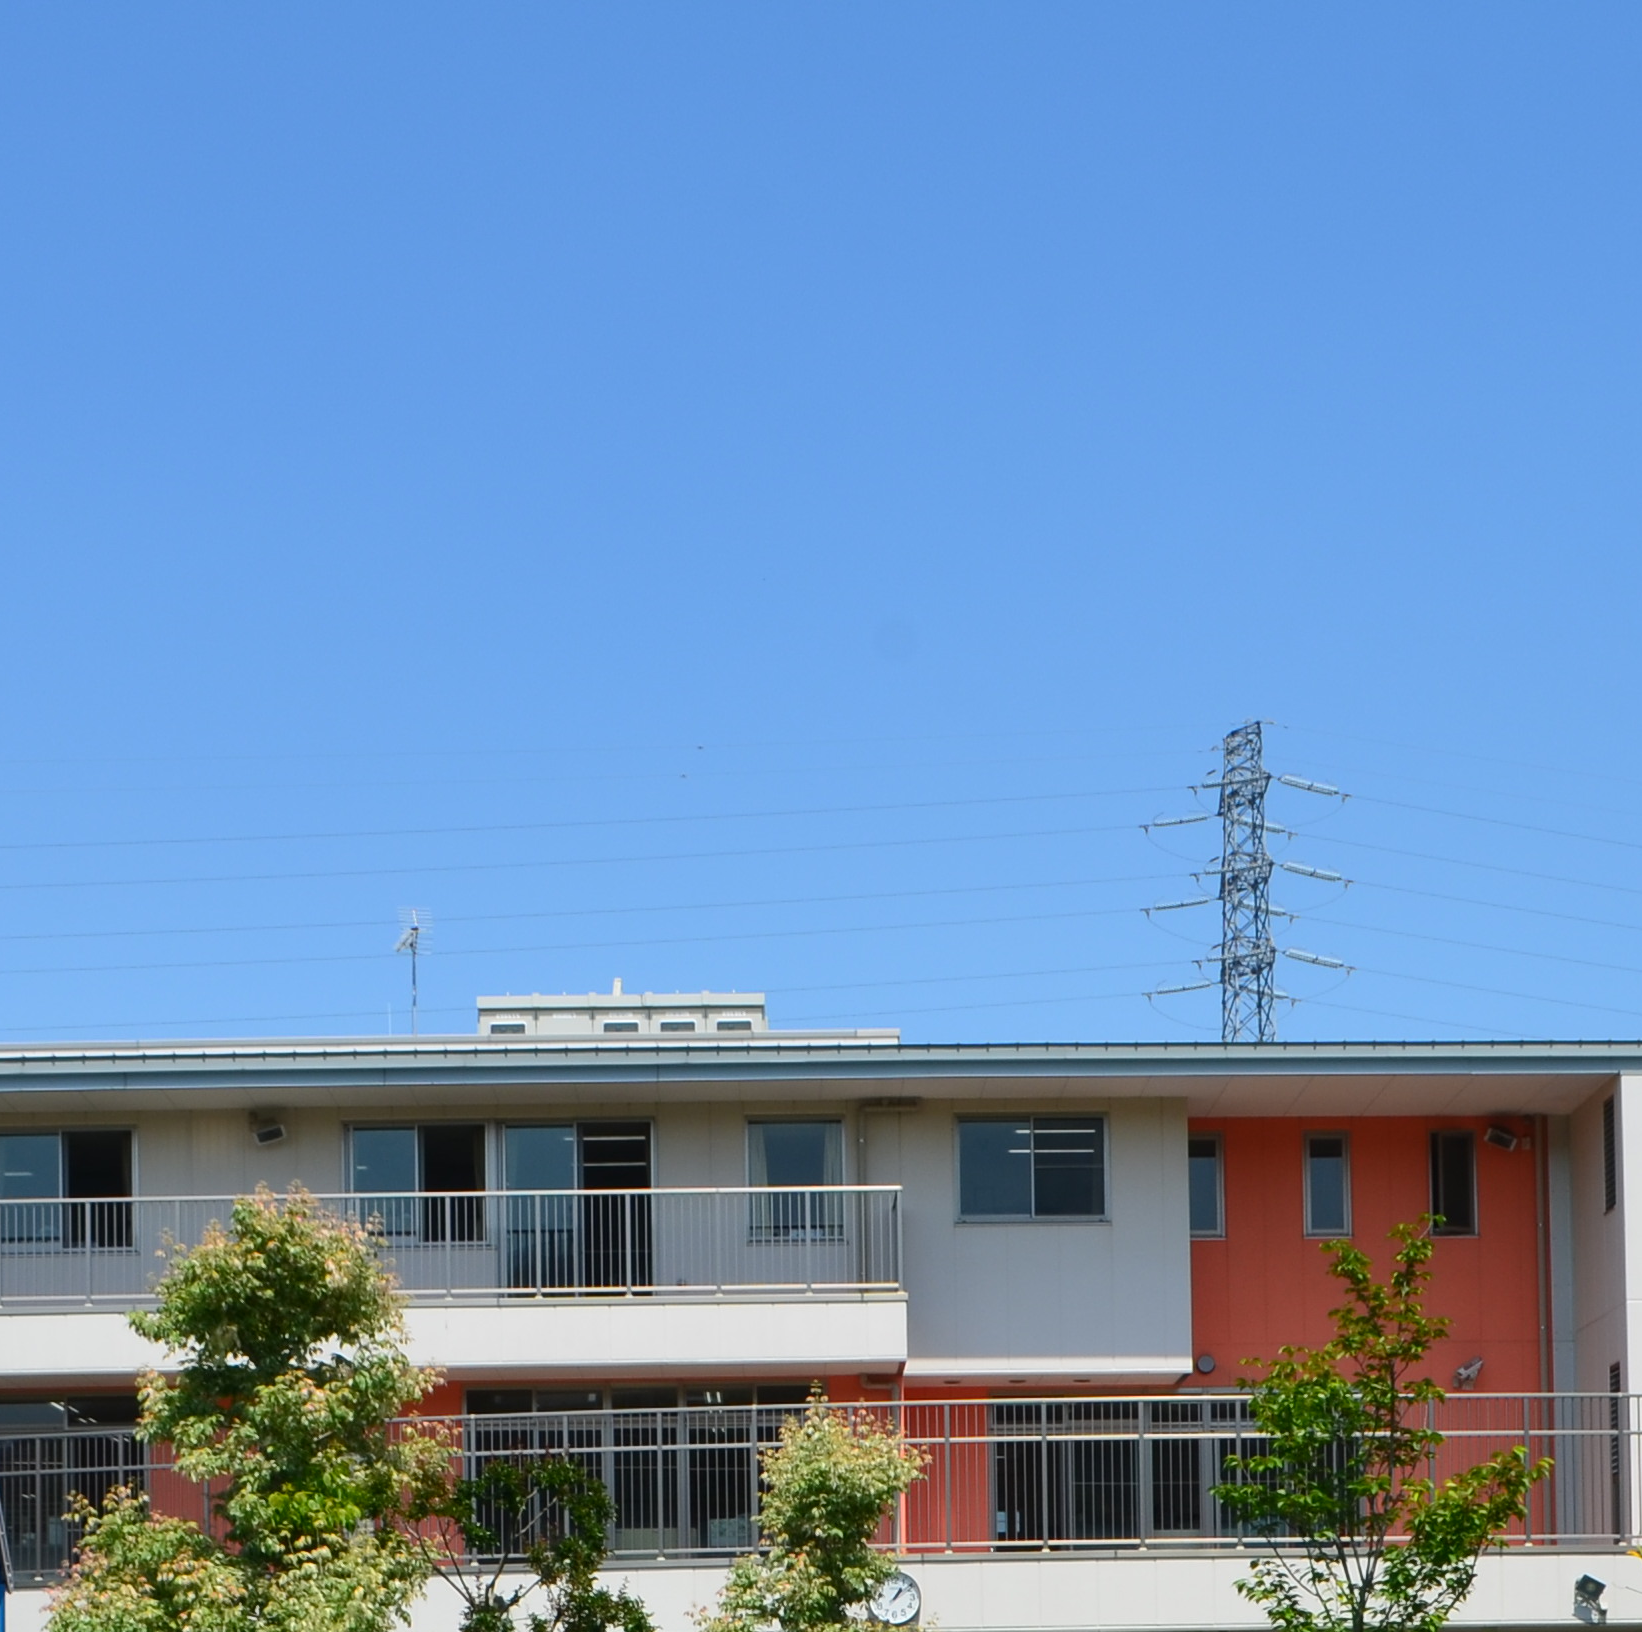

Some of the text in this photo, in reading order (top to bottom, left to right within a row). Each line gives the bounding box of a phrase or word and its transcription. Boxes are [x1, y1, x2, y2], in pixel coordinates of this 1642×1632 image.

[910, 1593, 915, 1601] 3
[877, 1602, 883, 1610] 8
[892, 1610, 897, 1618] 6
